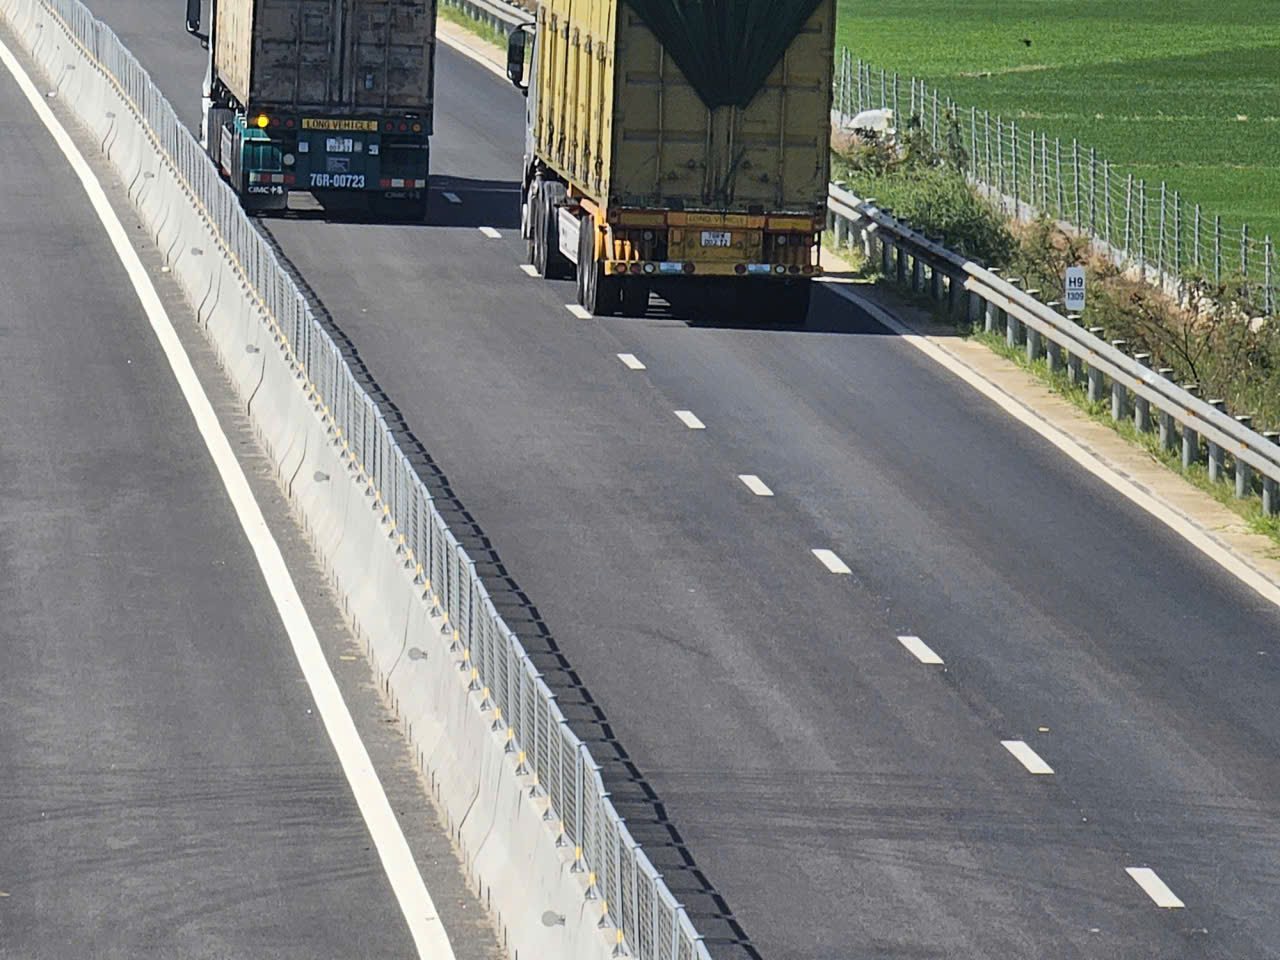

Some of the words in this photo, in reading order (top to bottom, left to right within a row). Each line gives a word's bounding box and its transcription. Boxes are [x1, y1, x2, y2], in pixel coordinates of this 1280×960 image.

[306, 120, 331, 129] LONG
[333, 120, 373, 131] VEHICLE
[310, 173, 365, 188] 76R-00723
[1068, 277, 1083, 287] H9
[1067, 292, 1084, 301] 1309
